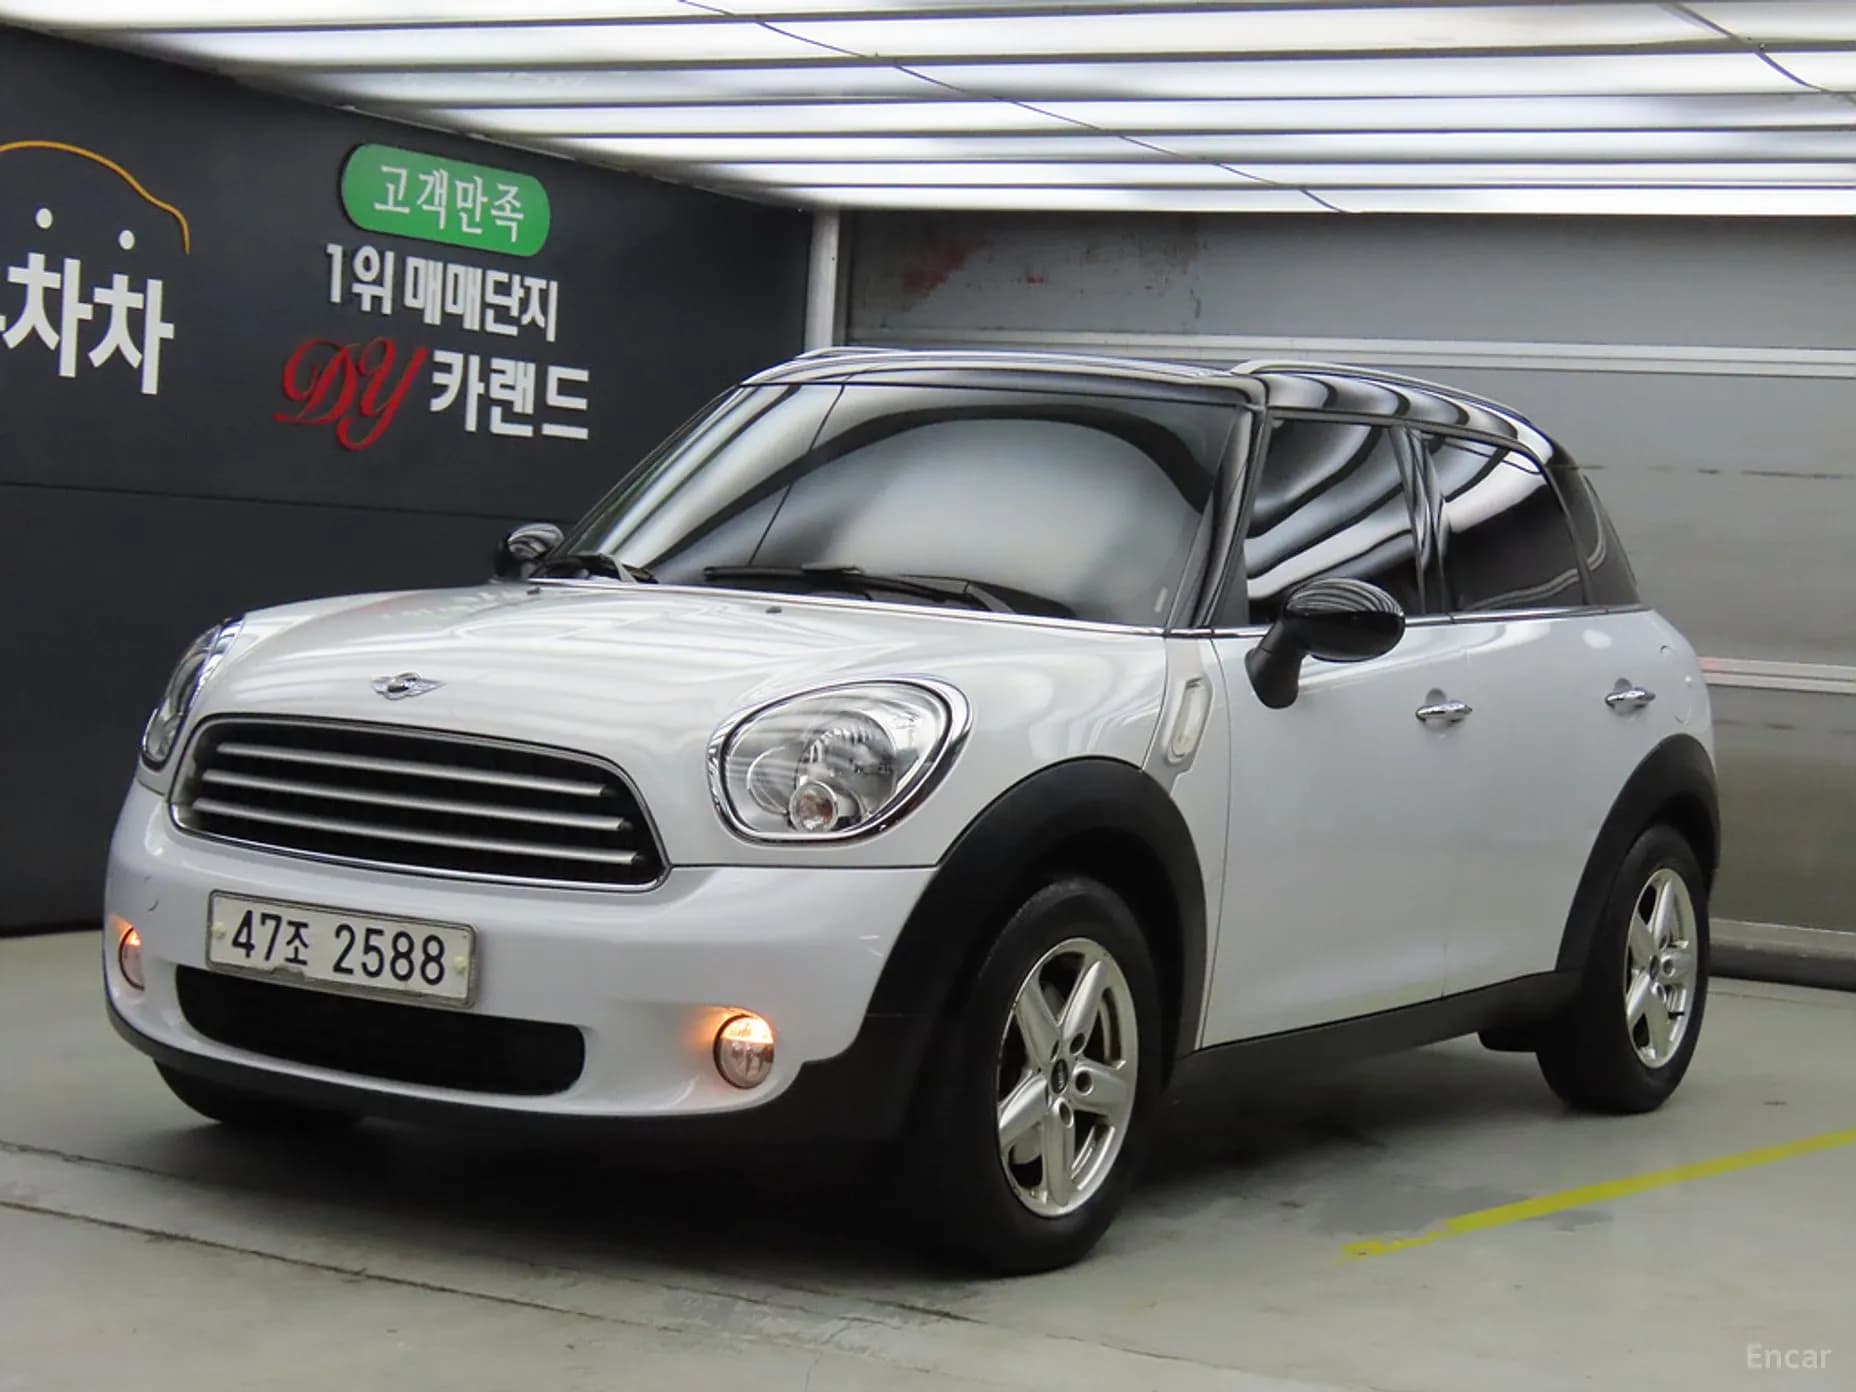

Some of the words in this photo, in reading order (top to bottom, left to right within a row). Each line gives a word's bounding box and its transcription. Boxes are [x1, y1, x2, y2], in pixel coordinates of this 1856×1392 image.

[373, 164, 524, 243] 고객만족
[0, 252, 175, 395] 차차
[325, 244, 394, 315] 1위
[403, 255, 559, 342] 매매단지
[272, 337, 428, 451] DY
[429, 350, 590, 440] 카랜드
[231, 909, 309, 966] 47조
[332, 923, 446, 986] 2588
